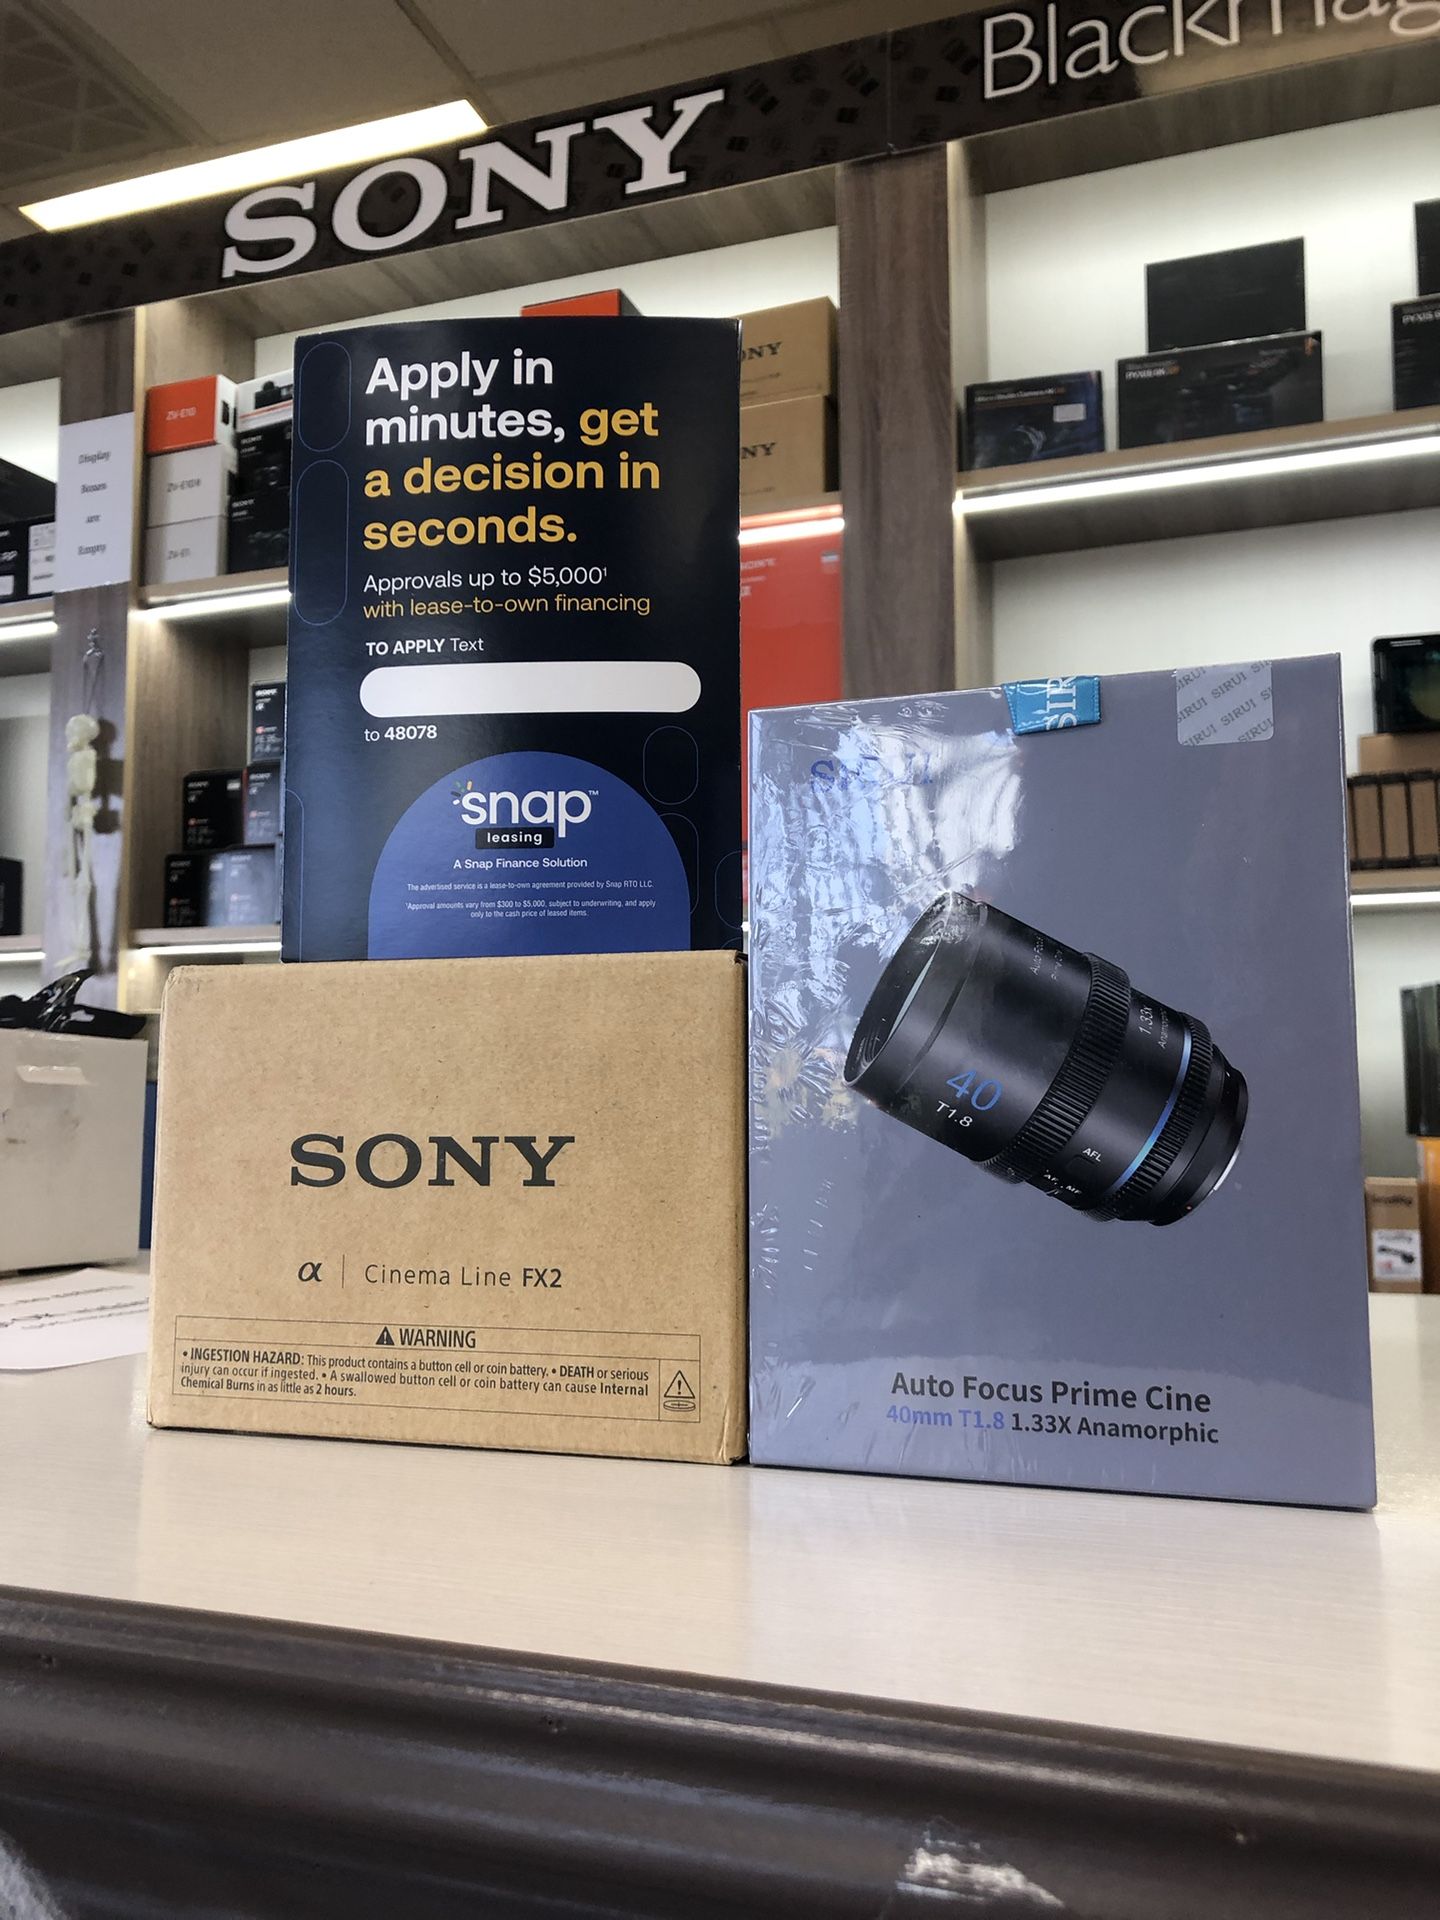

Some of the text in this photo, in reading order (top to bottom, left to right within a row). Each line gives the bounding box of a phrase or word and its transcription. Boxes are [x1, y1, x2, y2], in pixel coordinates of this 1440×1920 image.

[221, 89, 725, 278] SONY
[365, 348, 553, 400] Apply in
[366, 402, 659, 446] minutes, get
[364, 451, 660, 497] a decision in
[363, 505, 577, 550] seconds.
[363, 570, 462, 596] Approvals
[469, 569, 495, 591] up
[501, 568, 522, 586] to
[363, 593, 651, 618] with lease-to-own financing
[366, 637, 484, 656] TO APPLY Text
[1211, 672, 1247, 699] SIRUI
[1220, 698, 1257, 726] SIRUI
[364, 725, 438, 742] to 48078
[486, 831, 543, 846] leasing
[453, 857, 588, 871] A Snap Finance Solution
[407, 883, 420, 892] The
[420, 882, 453, 891] advertised
[453, 882, 477, 891] service
[477, 882, 484, 890] is
[489, 881, 531, 890] lease-to-own
[531, 881, 566, 892] agreement
[566, 880, 596, 891] provided
[596, 880, 605, 891] by
[605, 880, 622, 891] Snap
[623, 880, 638, 889] RTO
[436, 901, 465, 910] amounts
[465, 902, 479, 912] vary
[480, 901, 496, 910] from
[496, 900, 514, 910] $300
[514, 901, 522, 910] to
[548, 899, 572, 911] subject
[573, 900, 580, 909] to
[580, 899, 624, 910] underwriting,
[624, 899, 638, 909] and
[638, 899, 656, 911] apply
[470, 909, 589, 920] only to the cash price of leased items.
[946, 1069, 1004, 1111] 40
[936, 1100, 974, 1128] T1.8
[290, 1133, 575, 1188] SONY
[1082, 1147, 1102, 1162] AFL
[365, 1264, 450, 1285] Cinema
[461, 1266, 511, 1287] Line
[522, 1267, 562, 1288] FX2
[399, 1327, 476, 1349] WARNING
[190, 1347, 649, 1381] INGESTION HAZARD: This product contains a button cell or coin battery. DEATH or serious
[180, 1376, 357, 1397] Chemical Burns in as little as 2 hours.
[181, 1362, 649, 1396] injury can occur if ingested. A swallowed button cell or coin battery can cause Internal
[891, 1372, 1212, 1413] Auto Focus Prime Cine
[886, 1405, 1219, 1446] 40mm T1.8 1.33X Anamorphic
